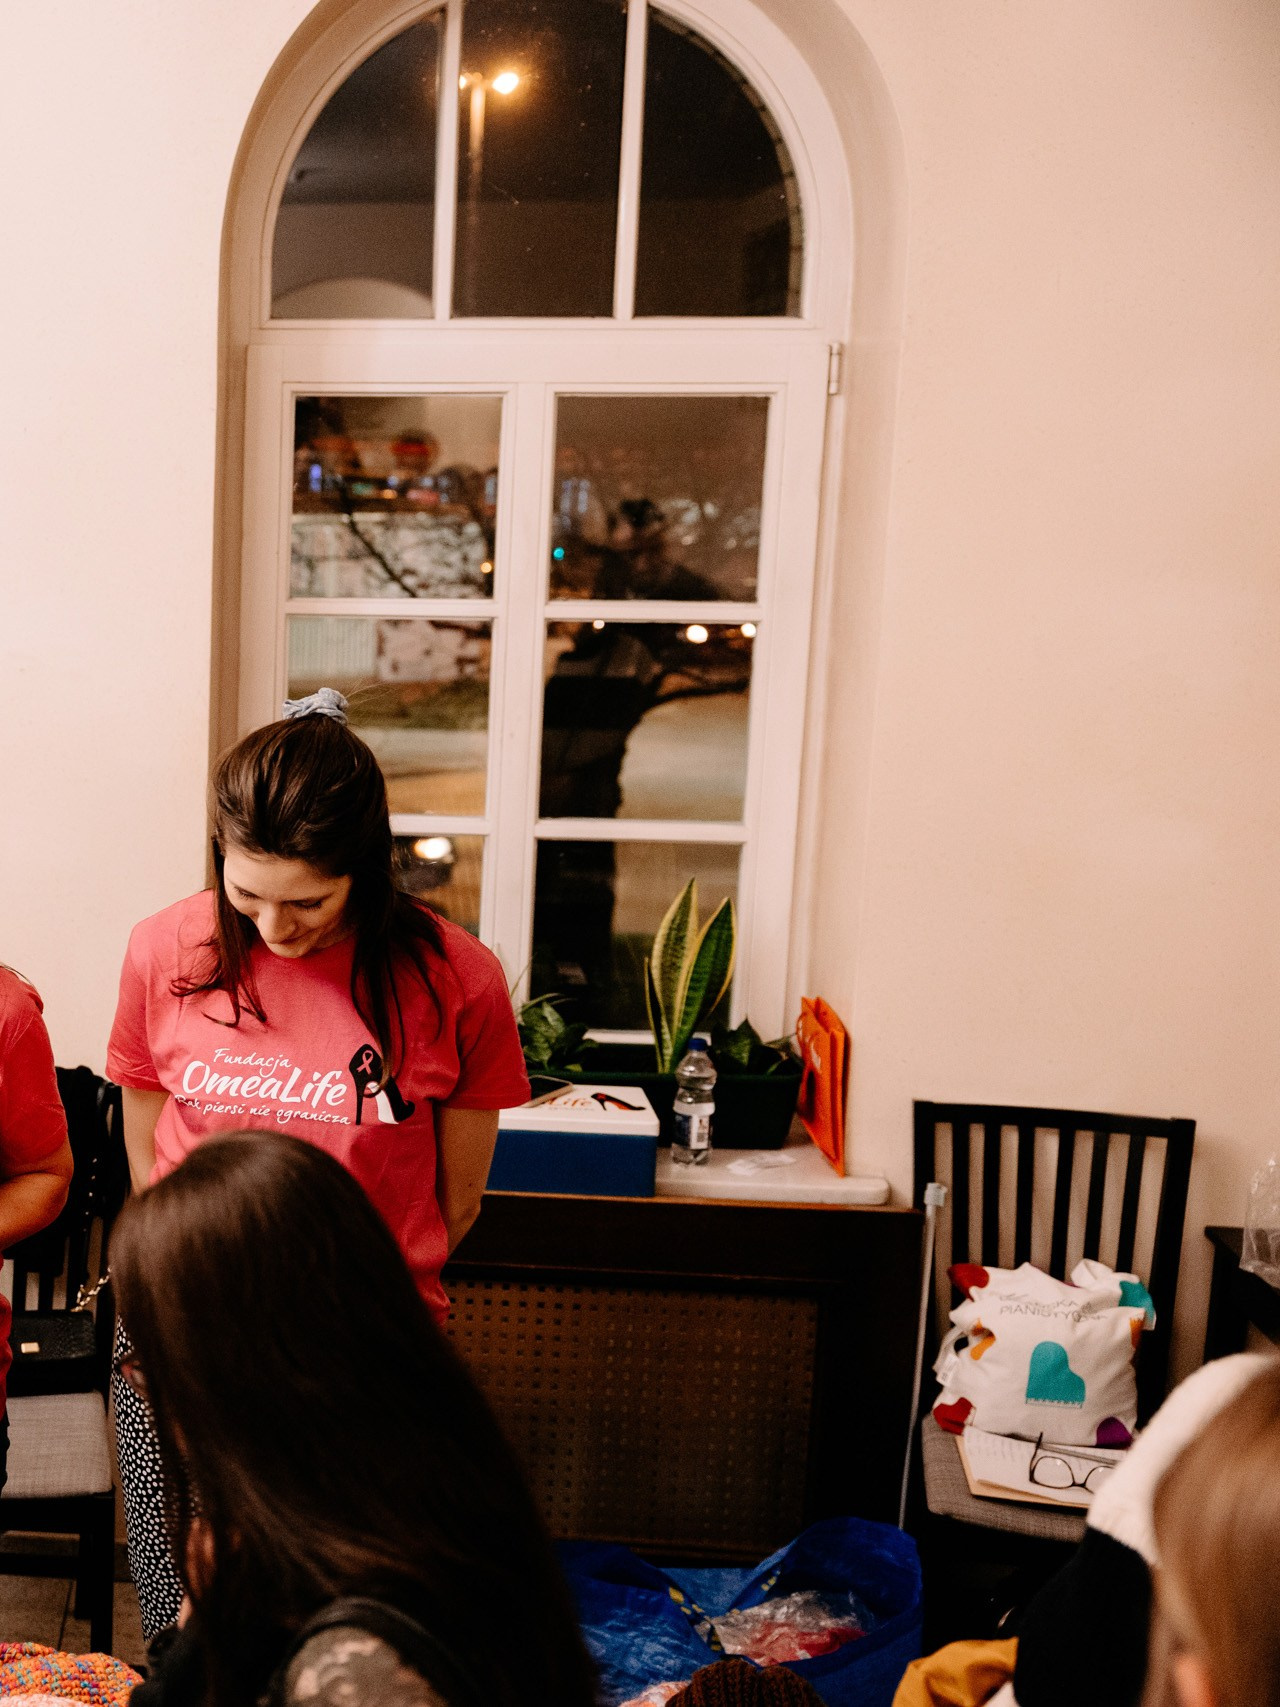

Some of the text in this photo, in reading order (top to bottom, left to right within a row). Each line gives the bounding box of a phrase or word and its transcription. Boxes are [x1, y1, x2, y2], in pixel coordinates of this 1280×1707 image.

[213, 1048, 292, 1078] Fundacja
[182, 1060, 348, 1109] OmeaLife
[174, 1094, 351, 1125] Rak piersi nie ogranicza
